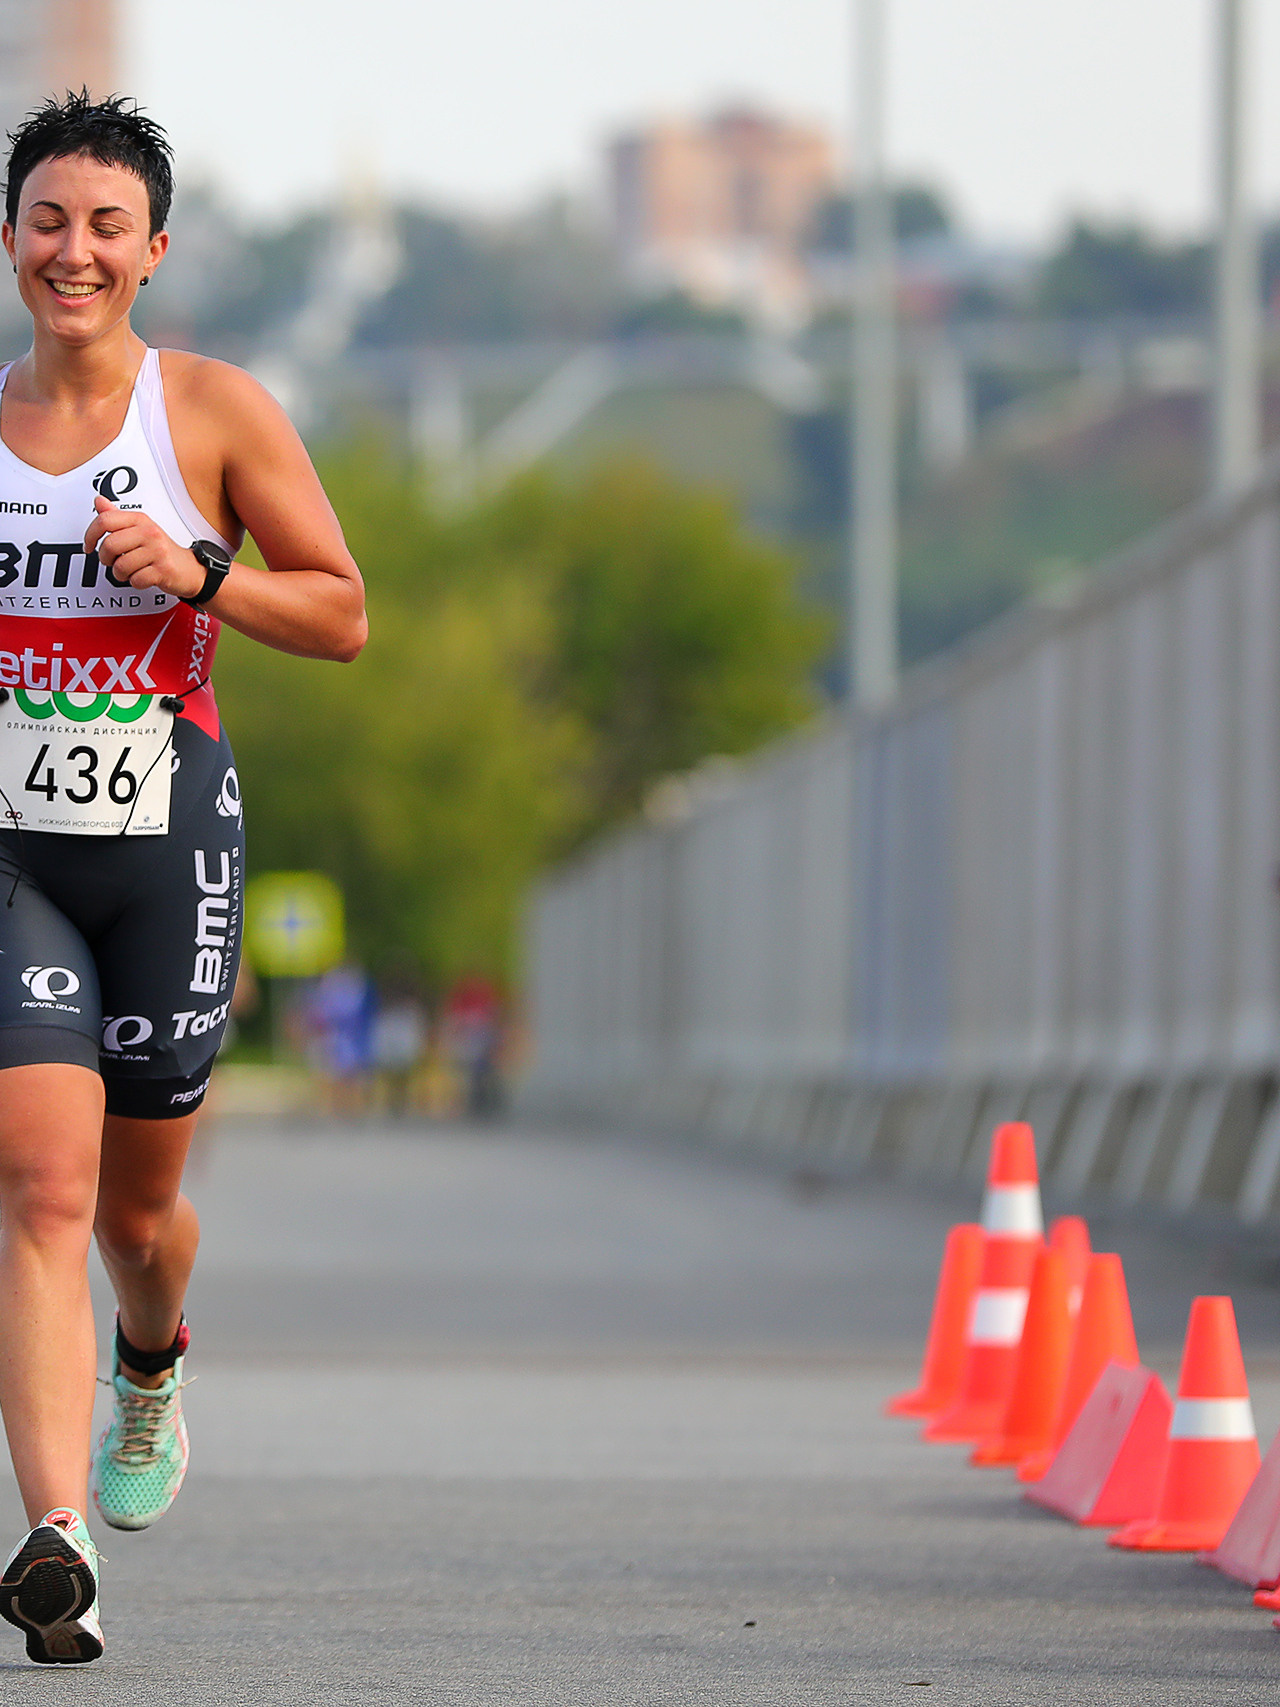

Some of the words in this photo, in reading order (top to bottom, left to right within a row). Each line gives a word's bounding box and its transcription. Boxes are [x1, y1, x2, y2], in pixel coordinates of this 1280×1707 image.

[189, 609, 212, 673] tixx
[6, 721, 87, 735] ОЛИМПИЙСКАЯ
[93, 727, 159, 736] ДИСТАНЦИЯ
[24, 743, 138, 805] 436
[189, 849, 231, 995] BMC
[219, 865, 240, 993] SWITZERLAND
[21, 1001, 55, 1010] PEARL
[172, 999, 231, 1041] Tacx
